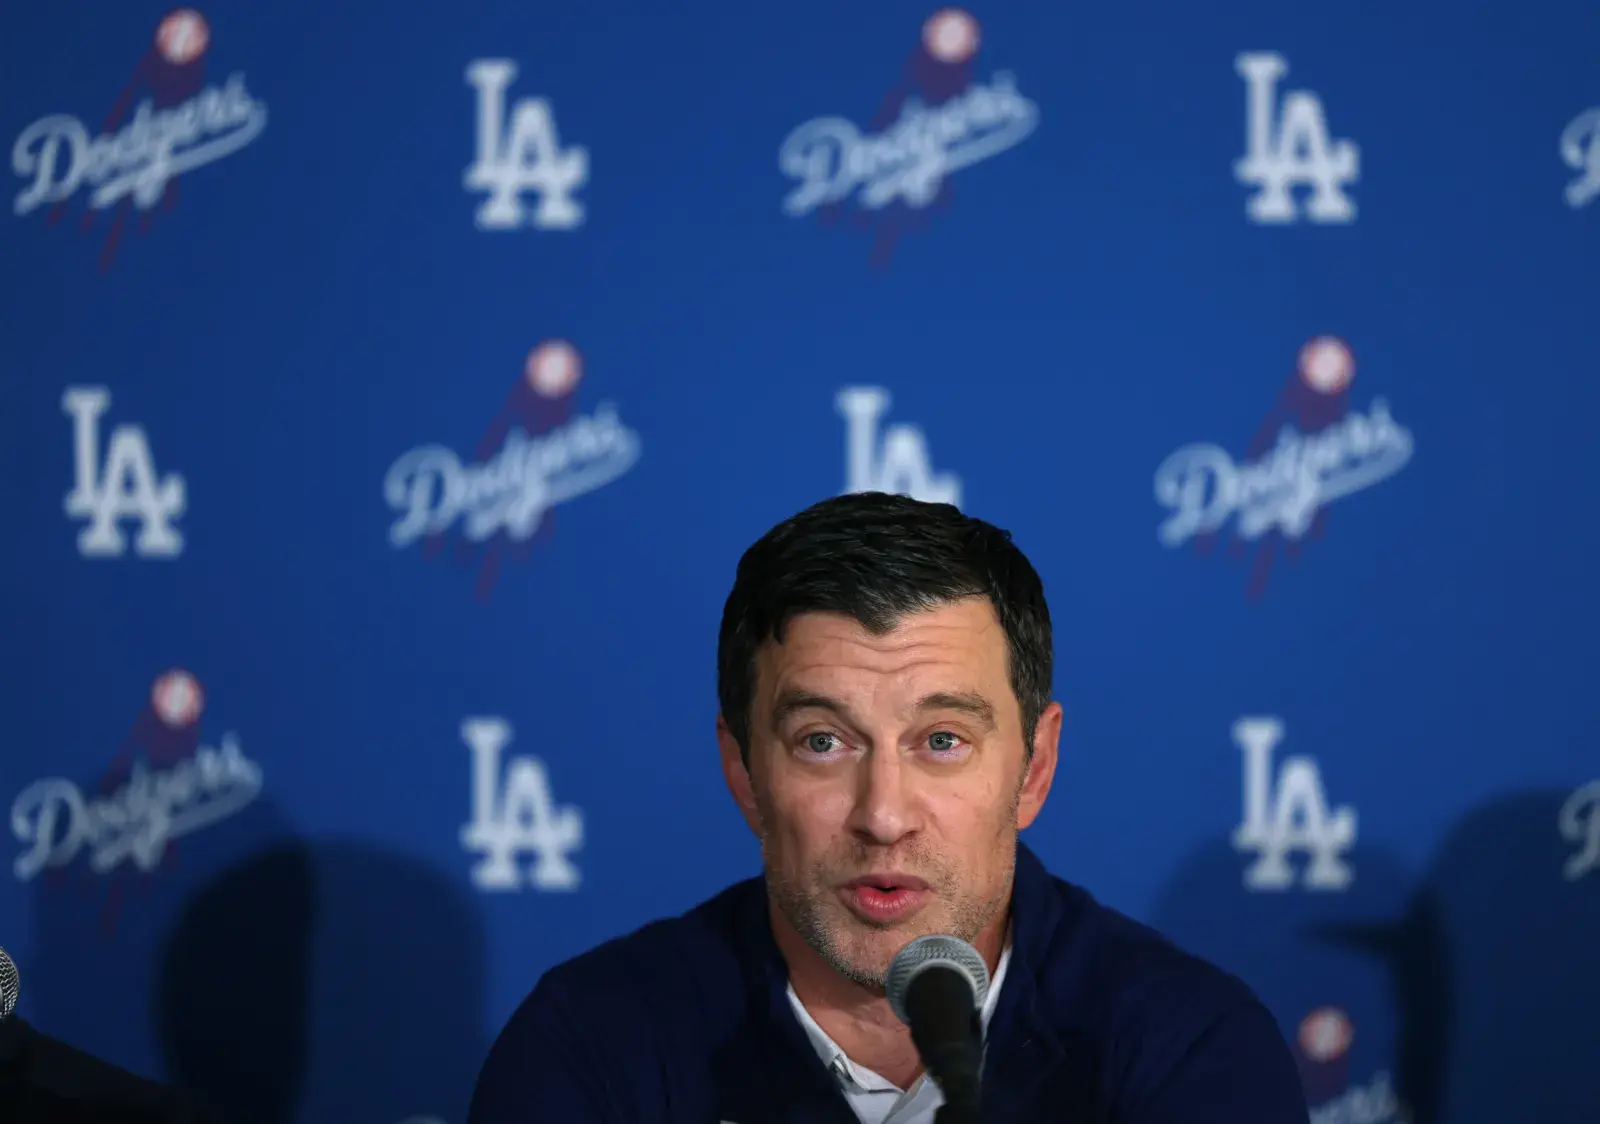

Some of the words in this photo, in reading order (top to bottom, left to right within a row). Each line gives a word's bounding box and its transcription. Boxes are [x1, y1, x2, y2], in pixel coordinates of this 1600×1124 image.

[11, 73, 267, 215] Dodgers
[464, 58, 590, 230] LA
[779, 71, 1039, 215] Dodgers
[1234, 51, 1361, 224] LA
[62, 386, 188, 558] LA
[383, 403, 641, 548] Dodgers
[1153, 399, 1414, 548] Dodgers
[10, 735, 263, 880] Dodgers
[460, 717, 585, 892] LA
[1232, 716, 1358, 891] LA
